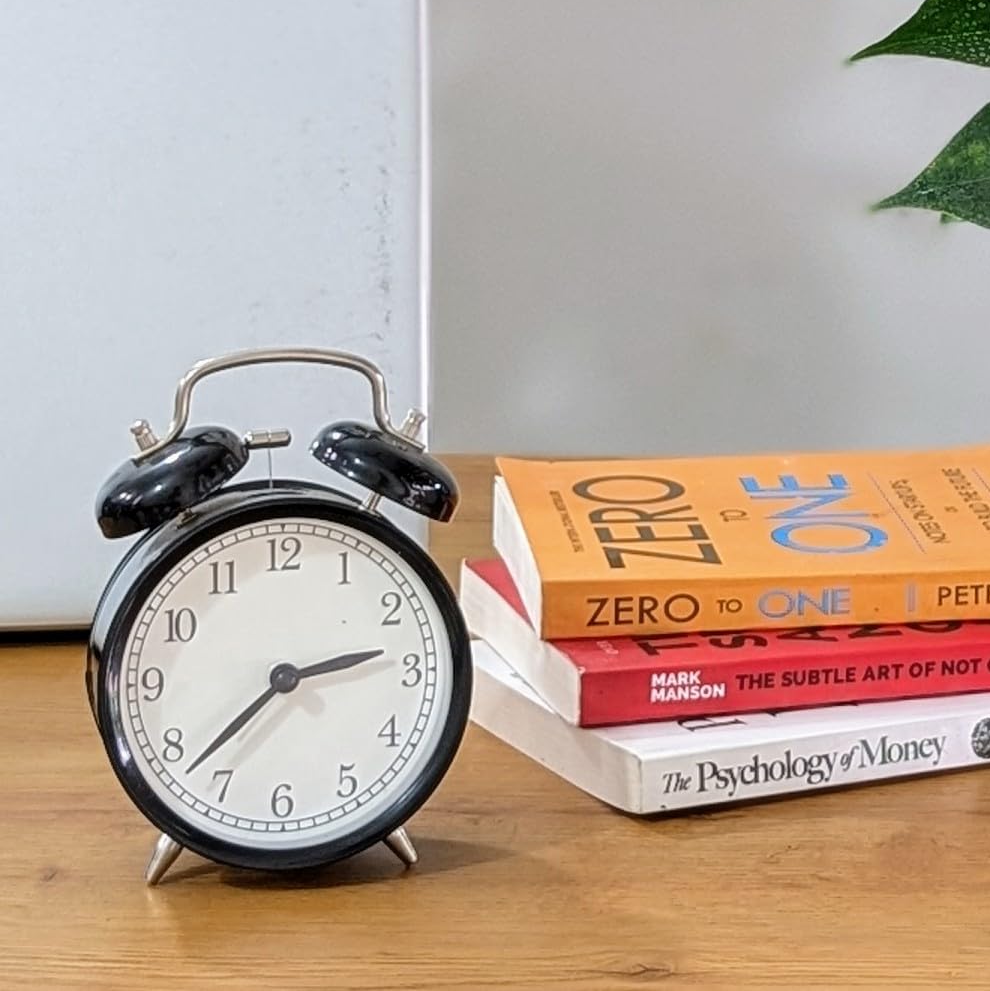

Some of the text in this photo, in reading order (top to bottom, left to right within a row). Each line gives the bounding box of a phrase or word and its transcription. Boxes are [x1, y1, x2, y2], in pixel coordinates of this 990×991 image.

[572, 475, 722, 568] ZERO
[720, 509, 750, 522] TO
[739, 474, 888, 554] ONE
[266, 537, 301, 571] 12
[337, 552, 352, 584] 1
[208, 560, 238, 594] 11
[380, 591, 402, 626] 2
[586, 593, 700, 627] ZERO
[716, 598, 743, 614] TO
[758, 587, 851, 619] ONE
[163, 609, 197, 643] 10
[141, 666, 165, 702] 9
[401, 653, 423, 688] 3
[651, 670, 702, 687] MARK
[735, 673, 776, 691] THE
[781, 666, 857, 687] SUBTLE
[862, 663, 904, 683] ART
[908, 661, 935, 679] OF
[941, 657, 982, 676] NOT
[650, 683, 726, 703] MANSON
[162, 728, 184, 763] 8
[378, 714, 401, 748] 4
[336, 763, 359, 798] 5
[662, 771, 692, 794] The
[696, 750, 838, 796] Psychology
[840, 745, 859, 772] of
[859, 735, 947, 769] Money
[211, 769, 235, 803] 7
[271, 784, 294, 818] 6
